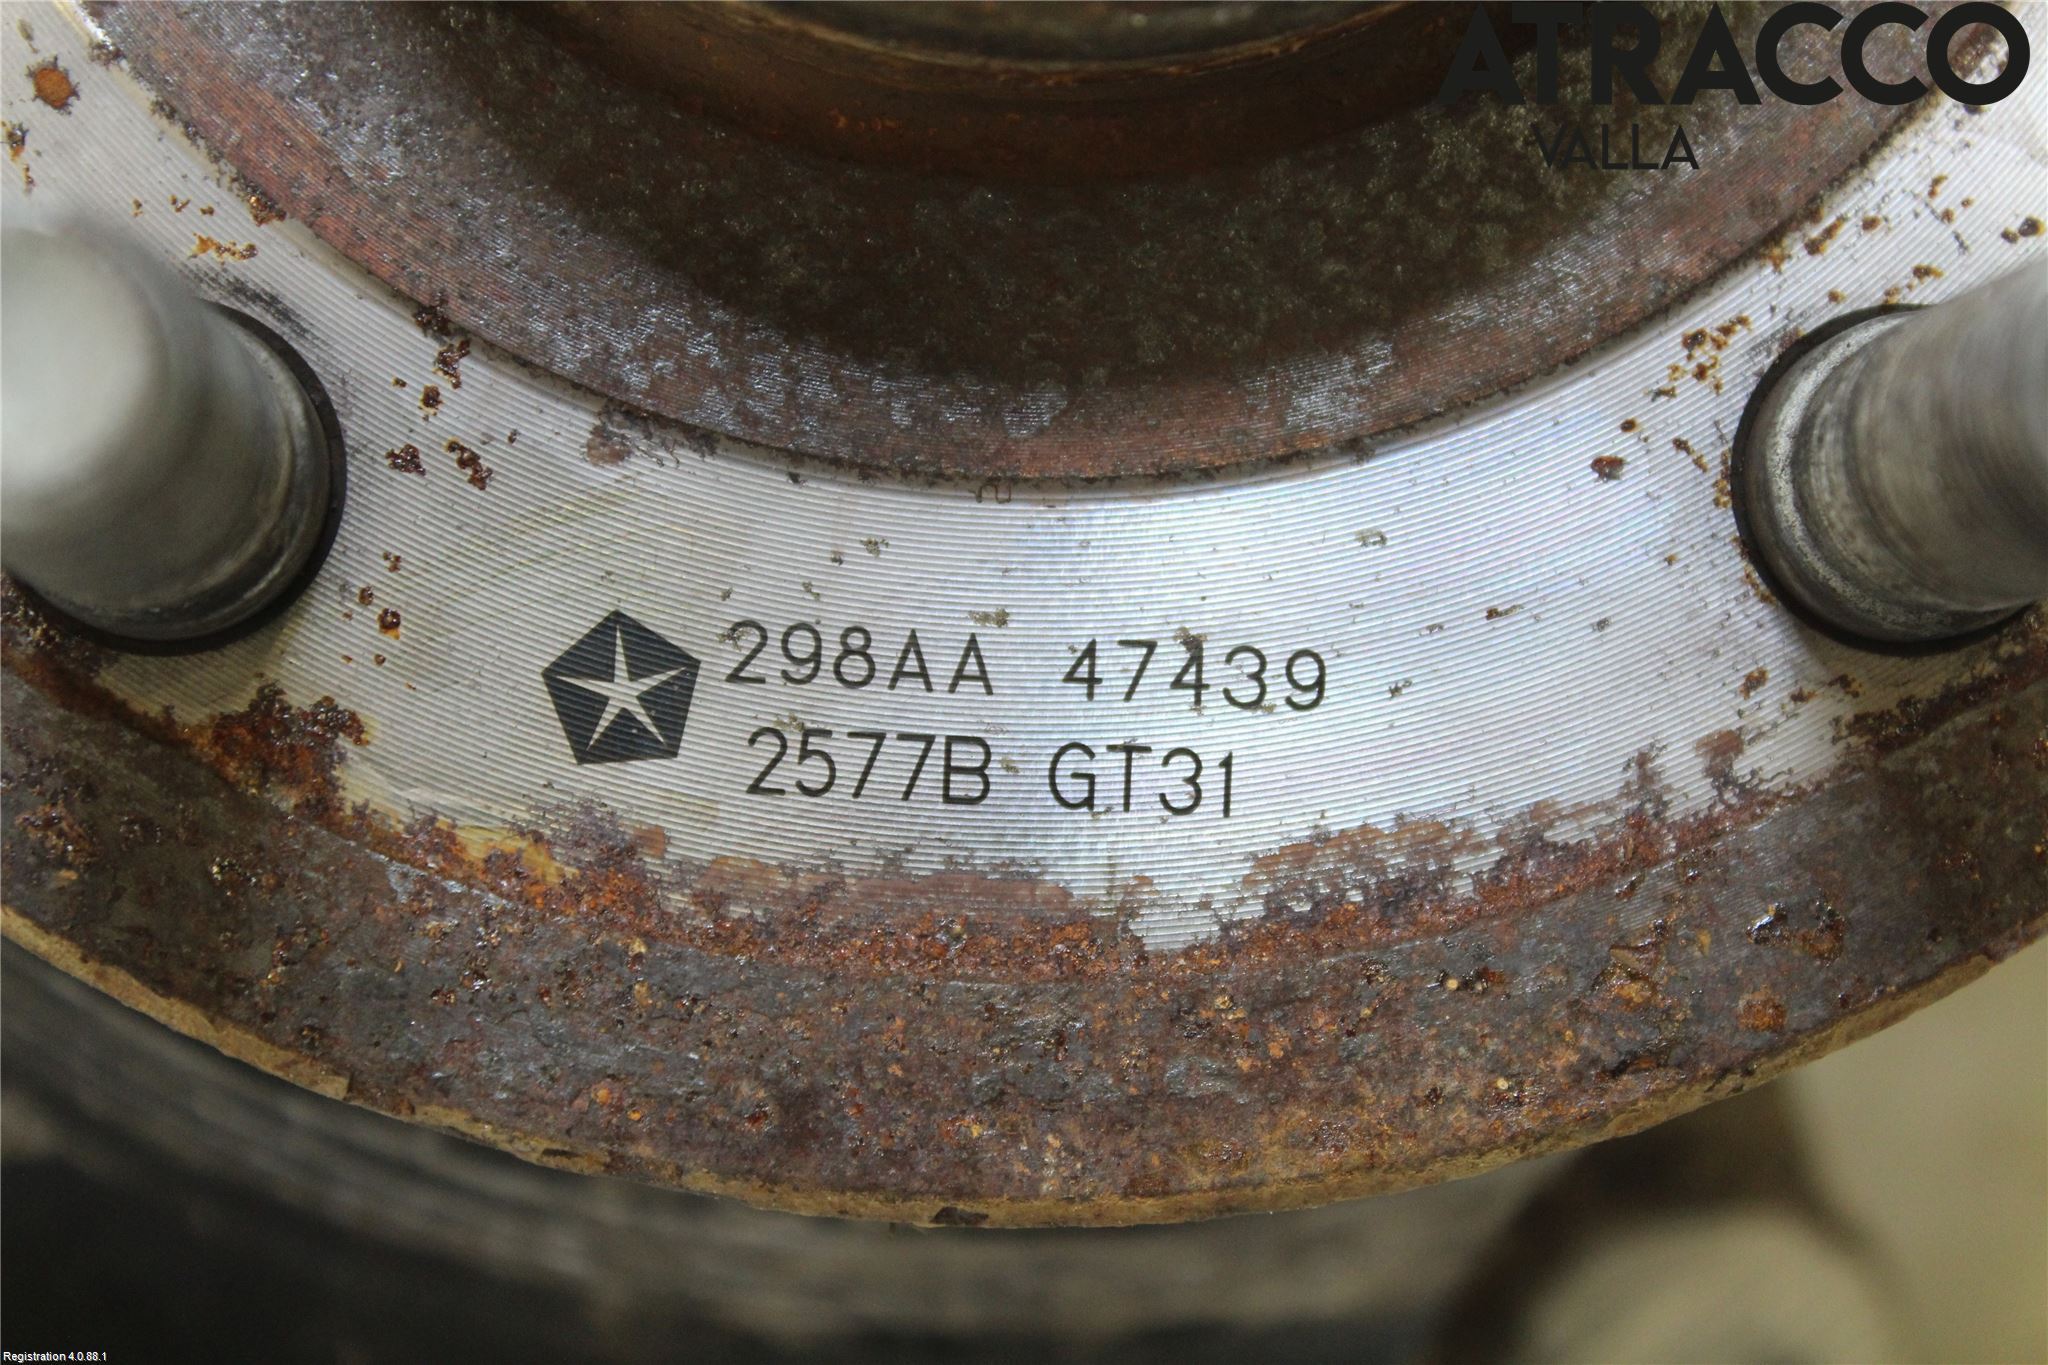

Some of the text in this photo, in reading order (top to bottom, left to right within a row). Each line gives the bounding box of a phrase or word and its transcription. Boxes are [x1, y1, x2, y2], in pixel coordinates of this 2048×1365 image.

[724, 619, 1327, 711] 298AA 47439
[746, 727, 1233, 818] 2577B GT31
